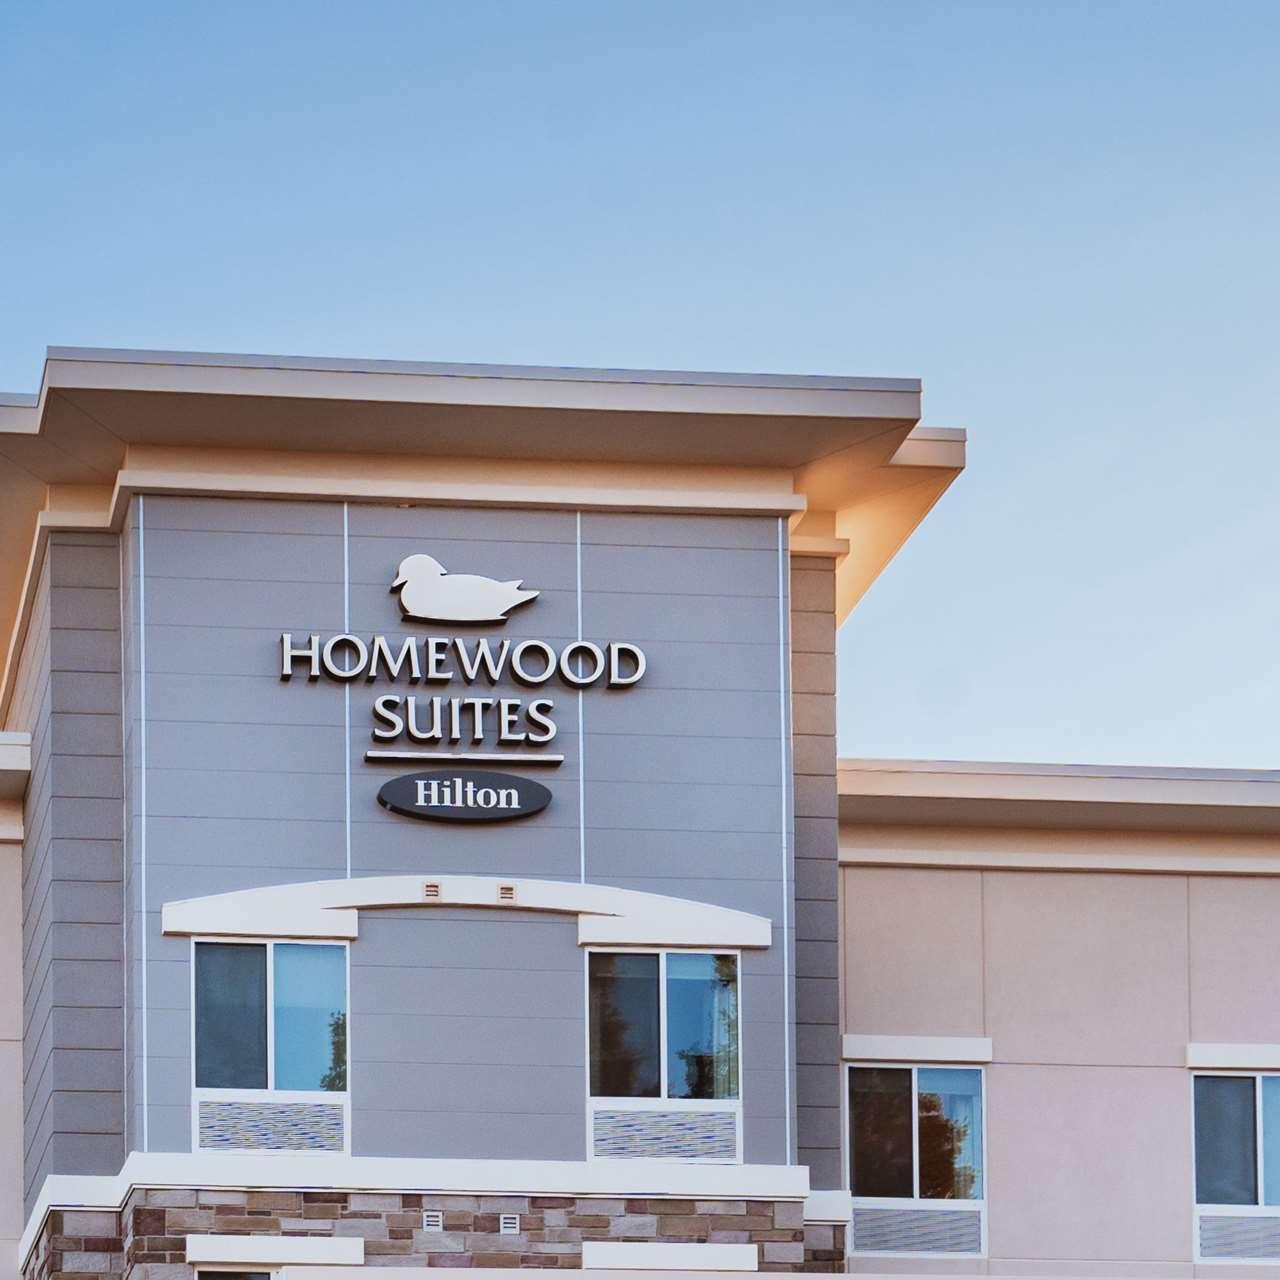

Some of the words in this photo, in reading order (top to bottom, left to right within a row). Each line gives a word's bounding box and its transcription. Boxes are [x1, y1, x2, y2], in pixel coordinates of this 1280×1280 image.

[281, 633, 646, 688] HOMEWOOD
[372, 694, 557, 744] SUITES
[415, 777, 520, 809] Hilton
